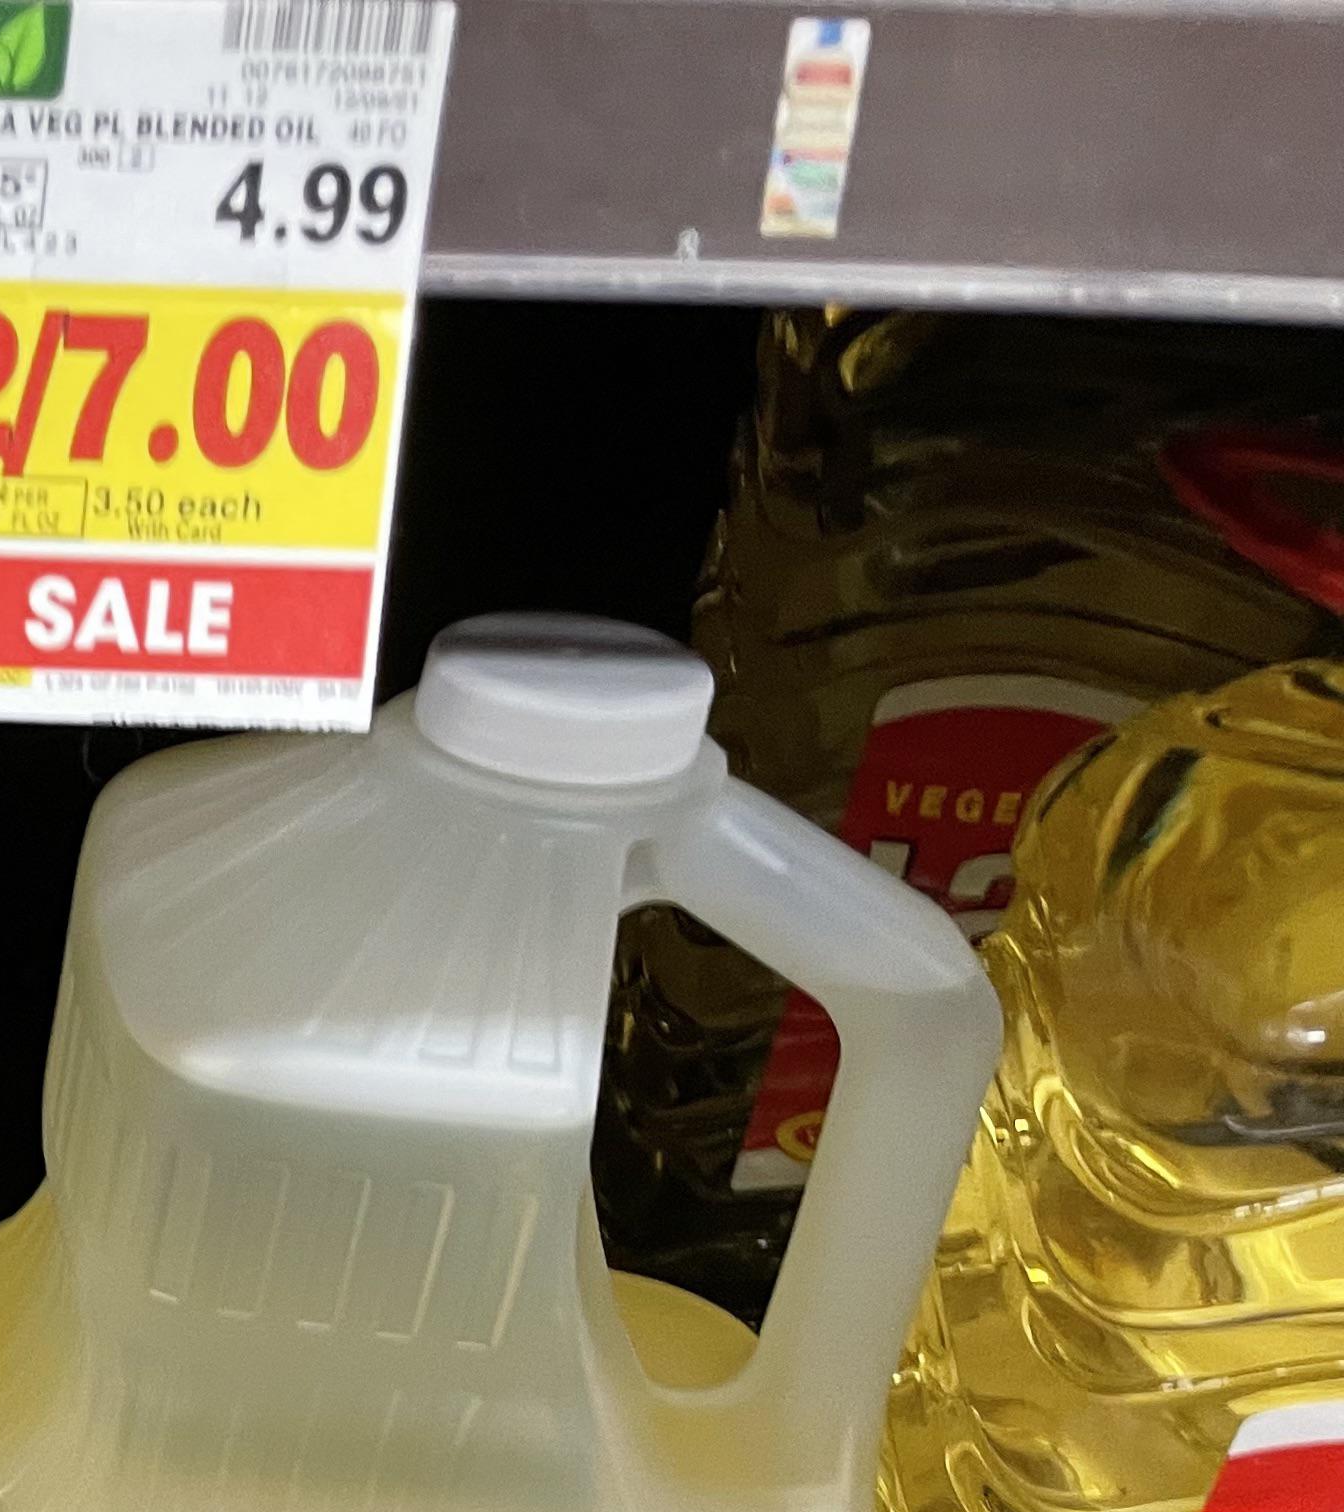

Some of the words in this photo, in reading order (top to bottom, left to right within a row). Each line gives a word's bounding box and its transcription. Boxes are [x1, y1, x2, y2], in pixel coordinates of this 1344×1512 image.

[137, 110, 265, 141] BLENDED
[274, 114, 315, 143] OIL
[216, 161, 409, 245] 4.99
[93, 485, 165, 517] 3.50
[179, 489, 261, 523] each
[127, 515, 168, 541] With
[176, 517, 223, 543] Card
[25, 574, 234, 656] SALE
